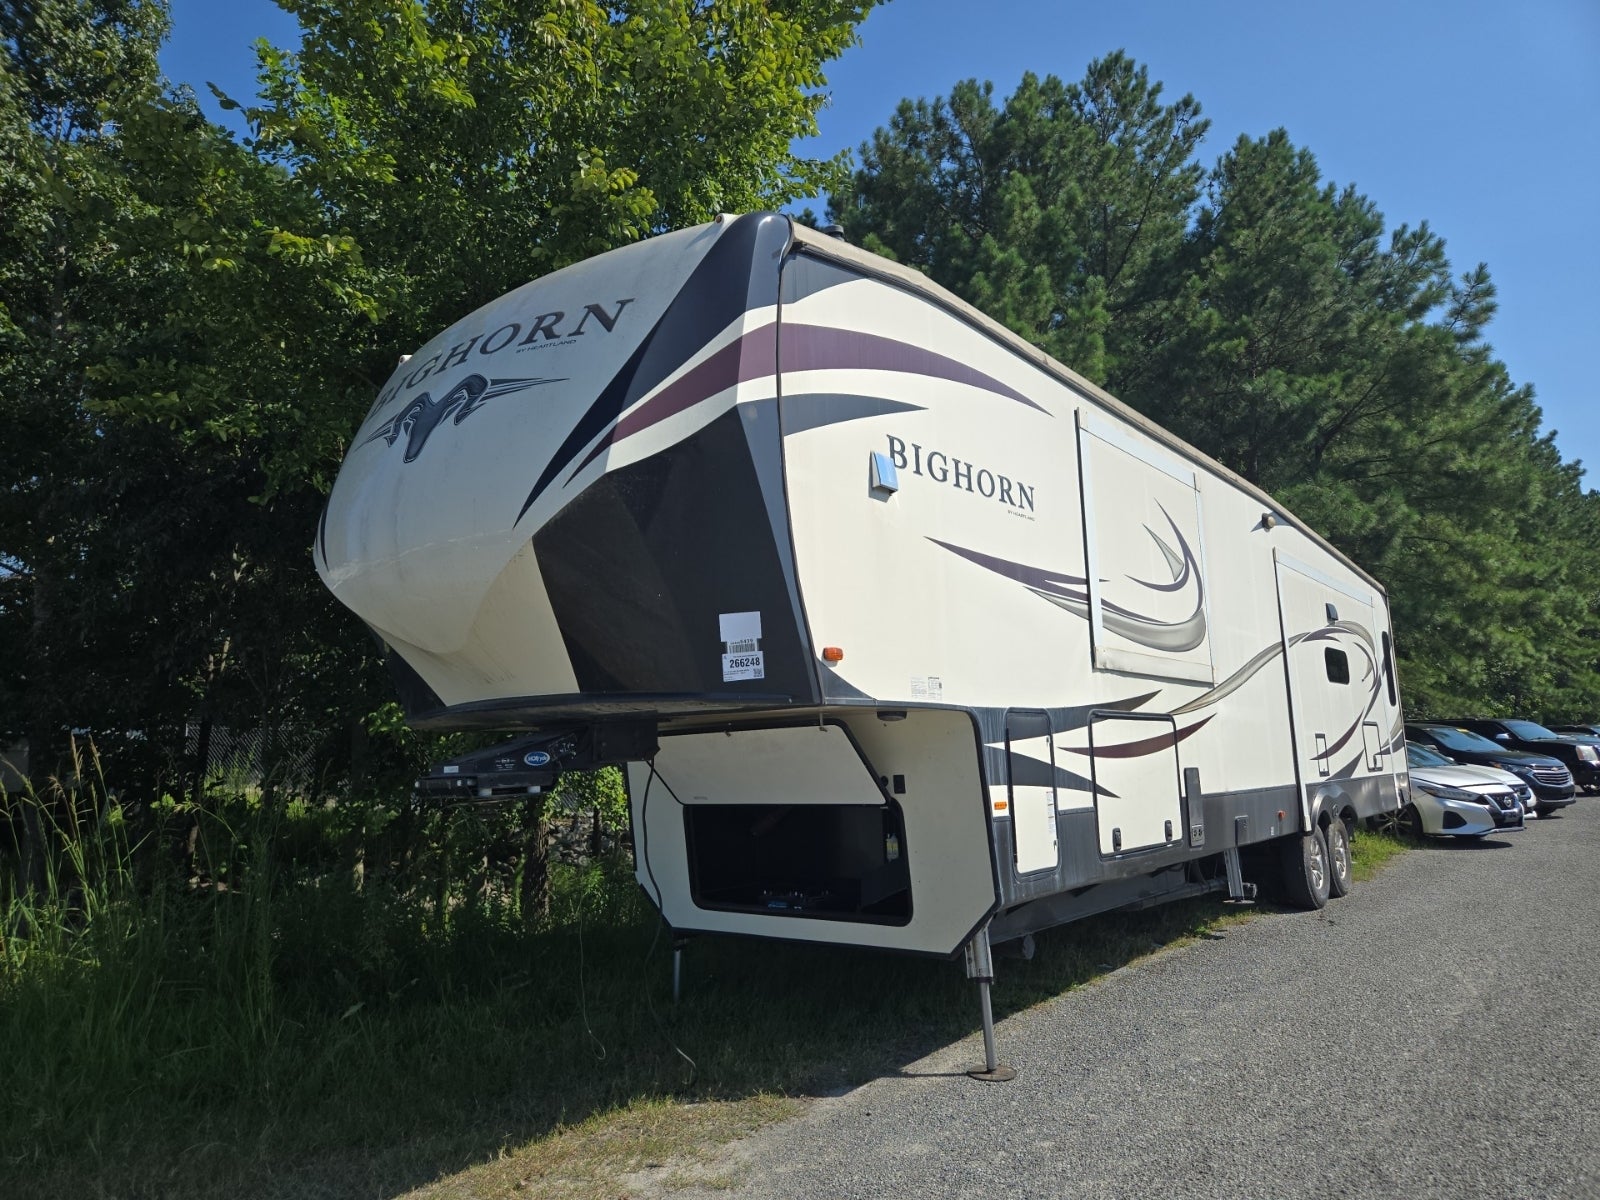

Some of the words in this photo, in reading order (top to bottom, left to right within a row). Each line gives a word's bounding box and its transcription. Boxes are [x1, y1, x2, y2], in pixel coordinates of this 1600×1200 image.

[367, 298, 635, 421] BIGHORN
[886, 434, 1035, 512] BIGHORN
[729, 657, 760, 668] 266248
